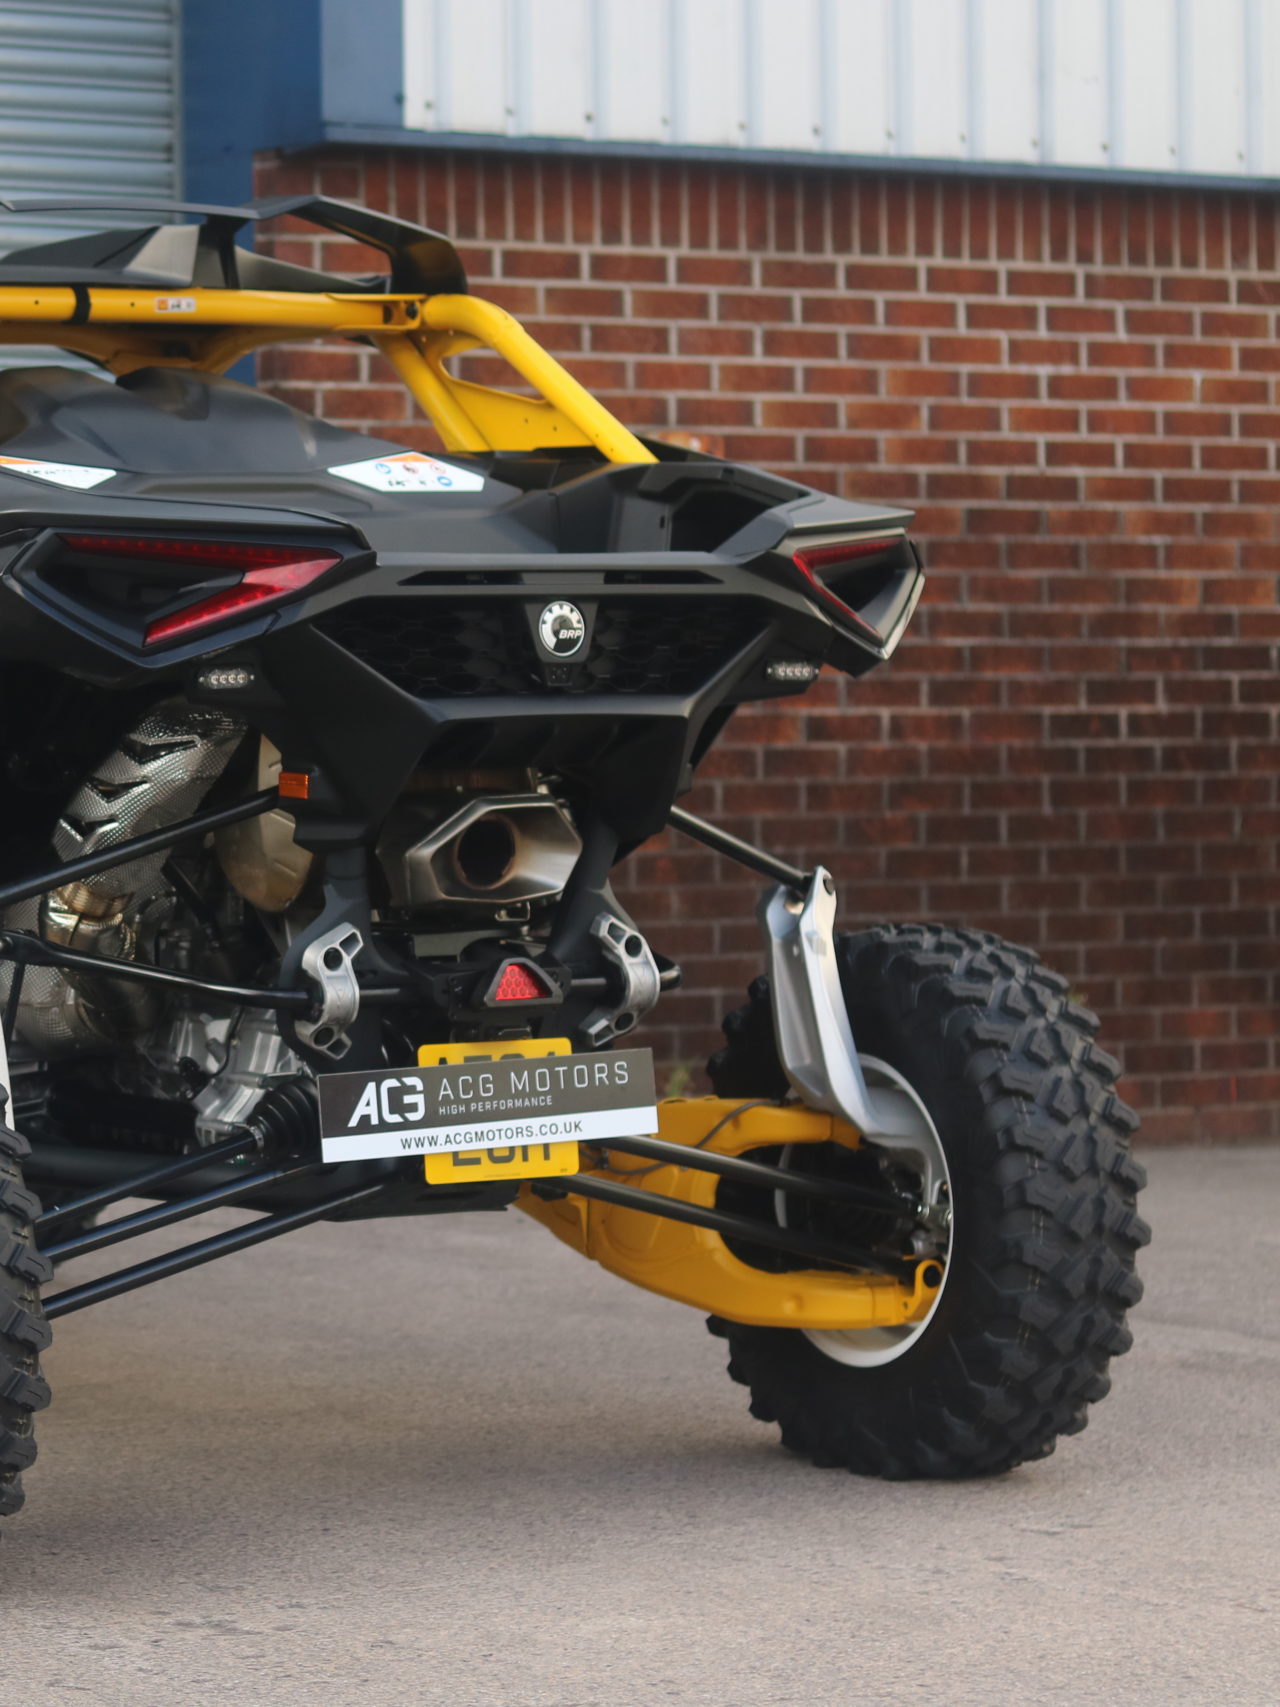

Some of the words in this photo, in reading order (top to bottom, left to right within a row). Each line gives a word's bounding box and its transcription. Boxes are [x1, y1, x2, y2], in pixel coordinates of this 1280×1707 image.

[559, 629, 582, 639] BRP
[438, 1073, 494, 1101] ACG
[510, 1061, 629, 1094] MOTORS
[347, 1076, 426, 1127] ACG
[439, 1104, 466, 1116] HIGH
[471, 1095, 553, 1112] PERFORMANCE
[400, 1120, 583, 1150] WWW.ACGMOTORS.CO.UK
